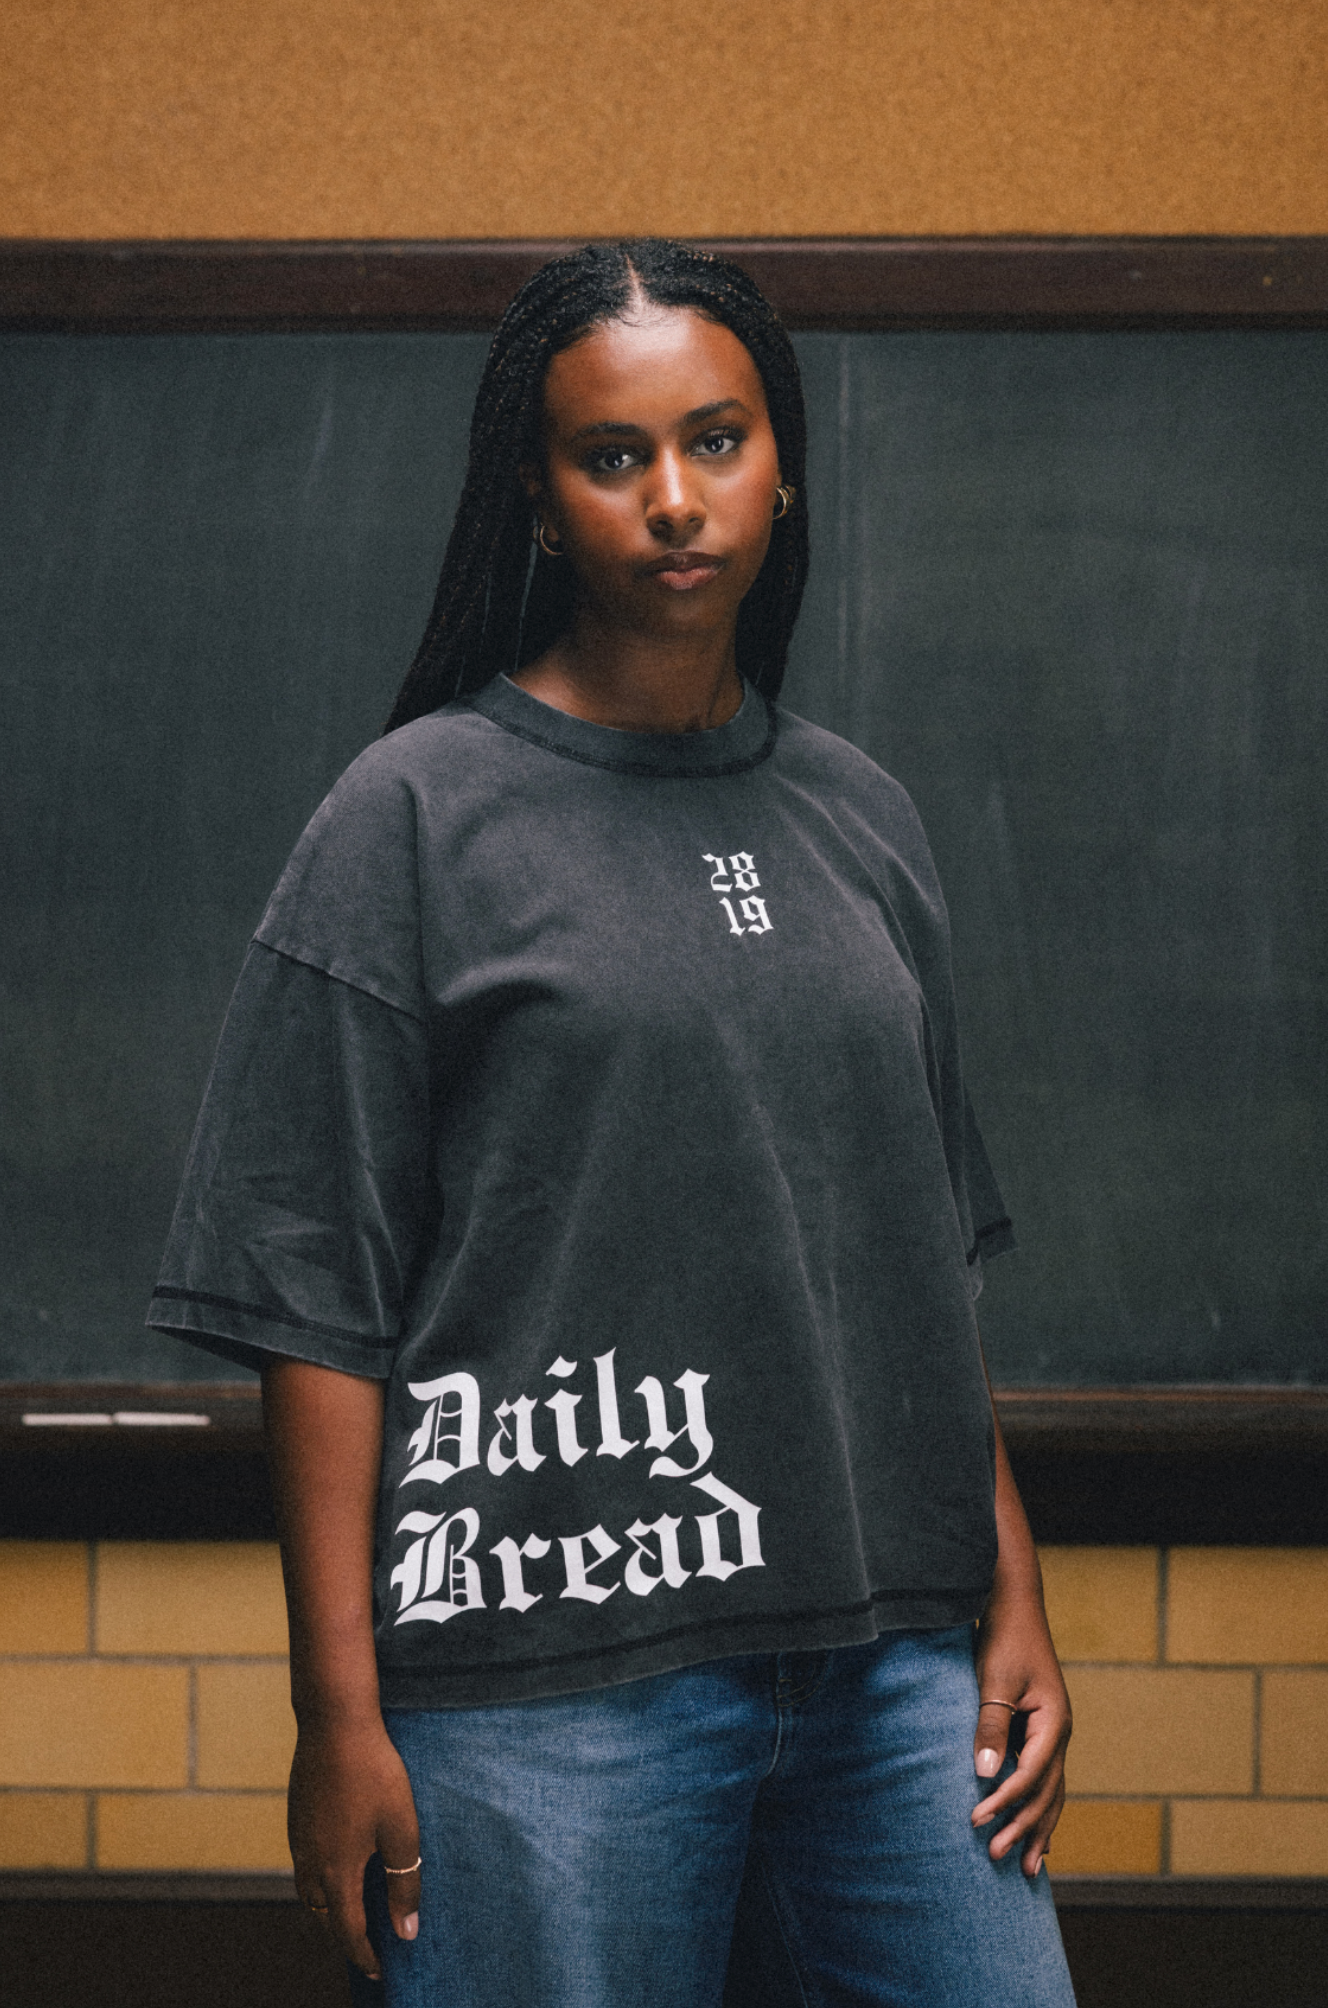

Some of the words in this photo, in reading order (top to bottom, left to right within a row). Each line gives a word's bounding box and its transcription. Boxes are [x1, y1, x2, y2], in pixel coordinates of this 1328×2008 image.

[701, 850, 761, 893] 28
[718, 894, 774, 936] 19
[399, 1346, 714, 1489] Daily
[390, 1471, 766, 1626] Bread
